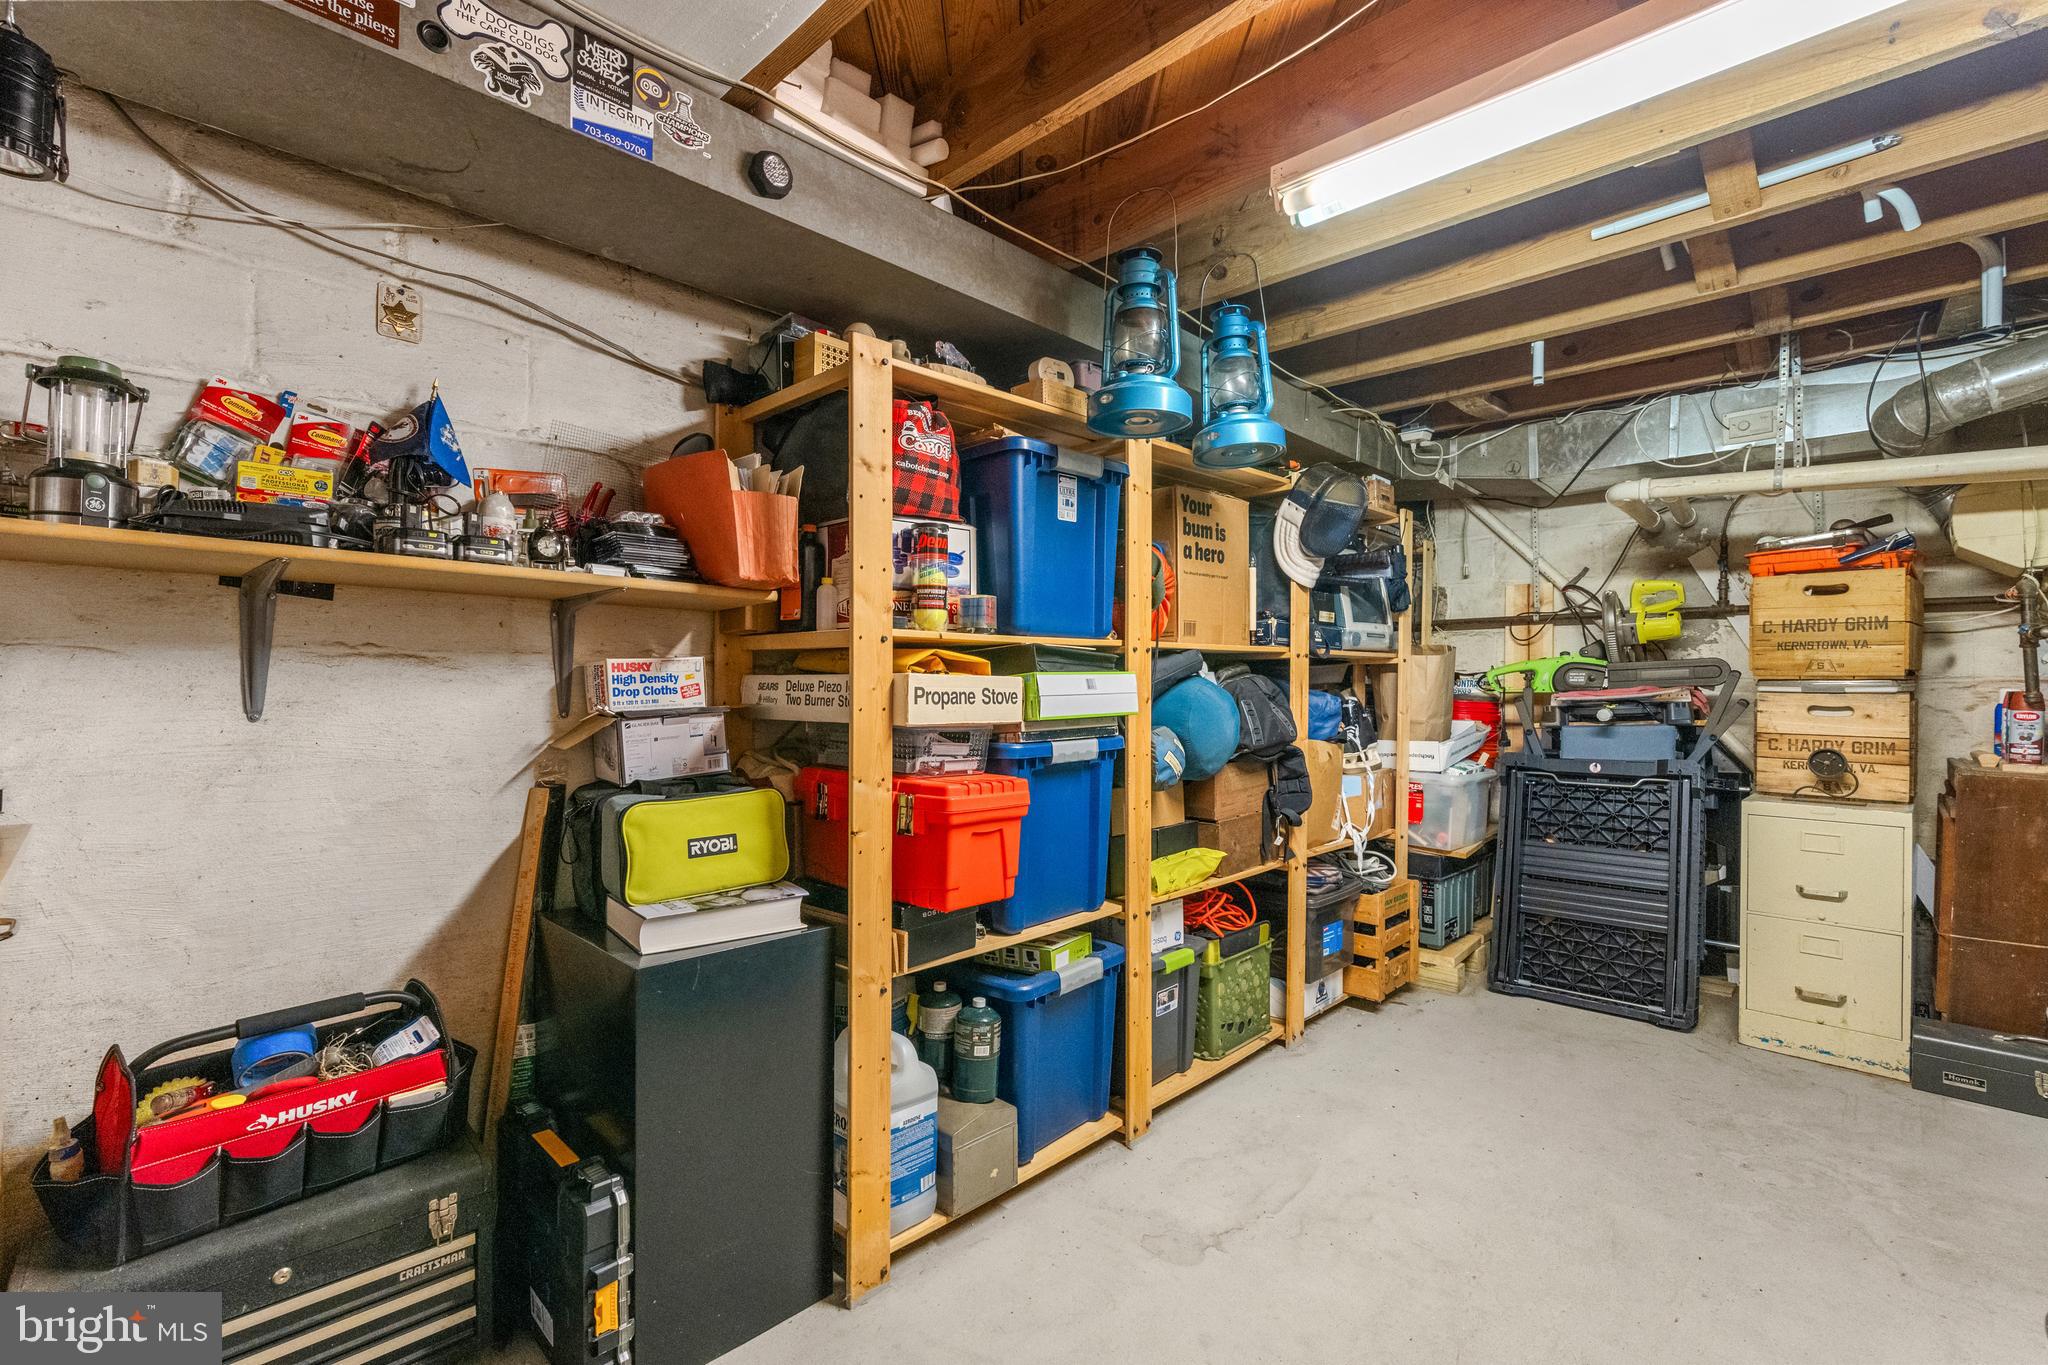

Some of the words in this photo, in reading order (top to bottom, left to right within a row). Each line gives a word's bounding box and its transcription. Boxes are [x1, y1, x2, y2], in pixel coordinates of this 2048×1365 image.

[354, 10, 396, 38] pliers
[460, 1, 481, 16] MY
[486, 12, 518, 35] DOG
[523, 30, 555, 52] DIGS
[455, 9, 476, 25] THE
[480, 20, 507, 39] CAPE
[509, 34, 532, 50] COD
[535, 46, 558, 63] DOG
[584, 34, 628, 67] WEIRD
[586, 93, 653, 130] INTEGRITY
[657, 113, 709, 142] CHAMPIONS
[584, 124, 647, 157] 703-639-0700
[224, 398, 258, 416] Command
[310, 431, 343, 445] Command
[1181, 493, 1213, 517] Your
[1183, 516, 1213, 540] bum
[1215, 522, 1226, 542] is
[1183, 544, 1192, 560] a
[1195, 541, 1225, 565] hero
[1762, 620, 1777, 634] C.
[1782, 618, 1838, 633] HARDY
[1845, 615, 1889, 631] GRIM
[1776, 640, 1850, 651] KERNSTOWN,
[1853, 639, 1872, 649] VA.
[611, 662, 653, 673] HUSKY
[611, 674, 636, 686] High
[639, 673, 679, 684] Density
[758, 681, 779, 691] SEARS
[785, 680, 815, 693] Deluxe
[818, 680, 843, 693] Piezo
[612, 687, 640, 698] Drop
[643, 685, 679, 696] Cloths
[785, 694, 802, 706] Two
[804, 694, 835, 707] Burner
[914, 686, 976, 709] Propane
[981, 687, 1018, 705] Stove
[1768, 738, 1783, 751] C.
[1851, 741, 1896, 756] GRIM
[1860, 764, 1880, 774] VA.
[1949, 1074, 1981, 1086] Homak
[278, 1090, 358, 1124] HUSKY
[399, 1250, 466, 1281] CRAFTSMAN
